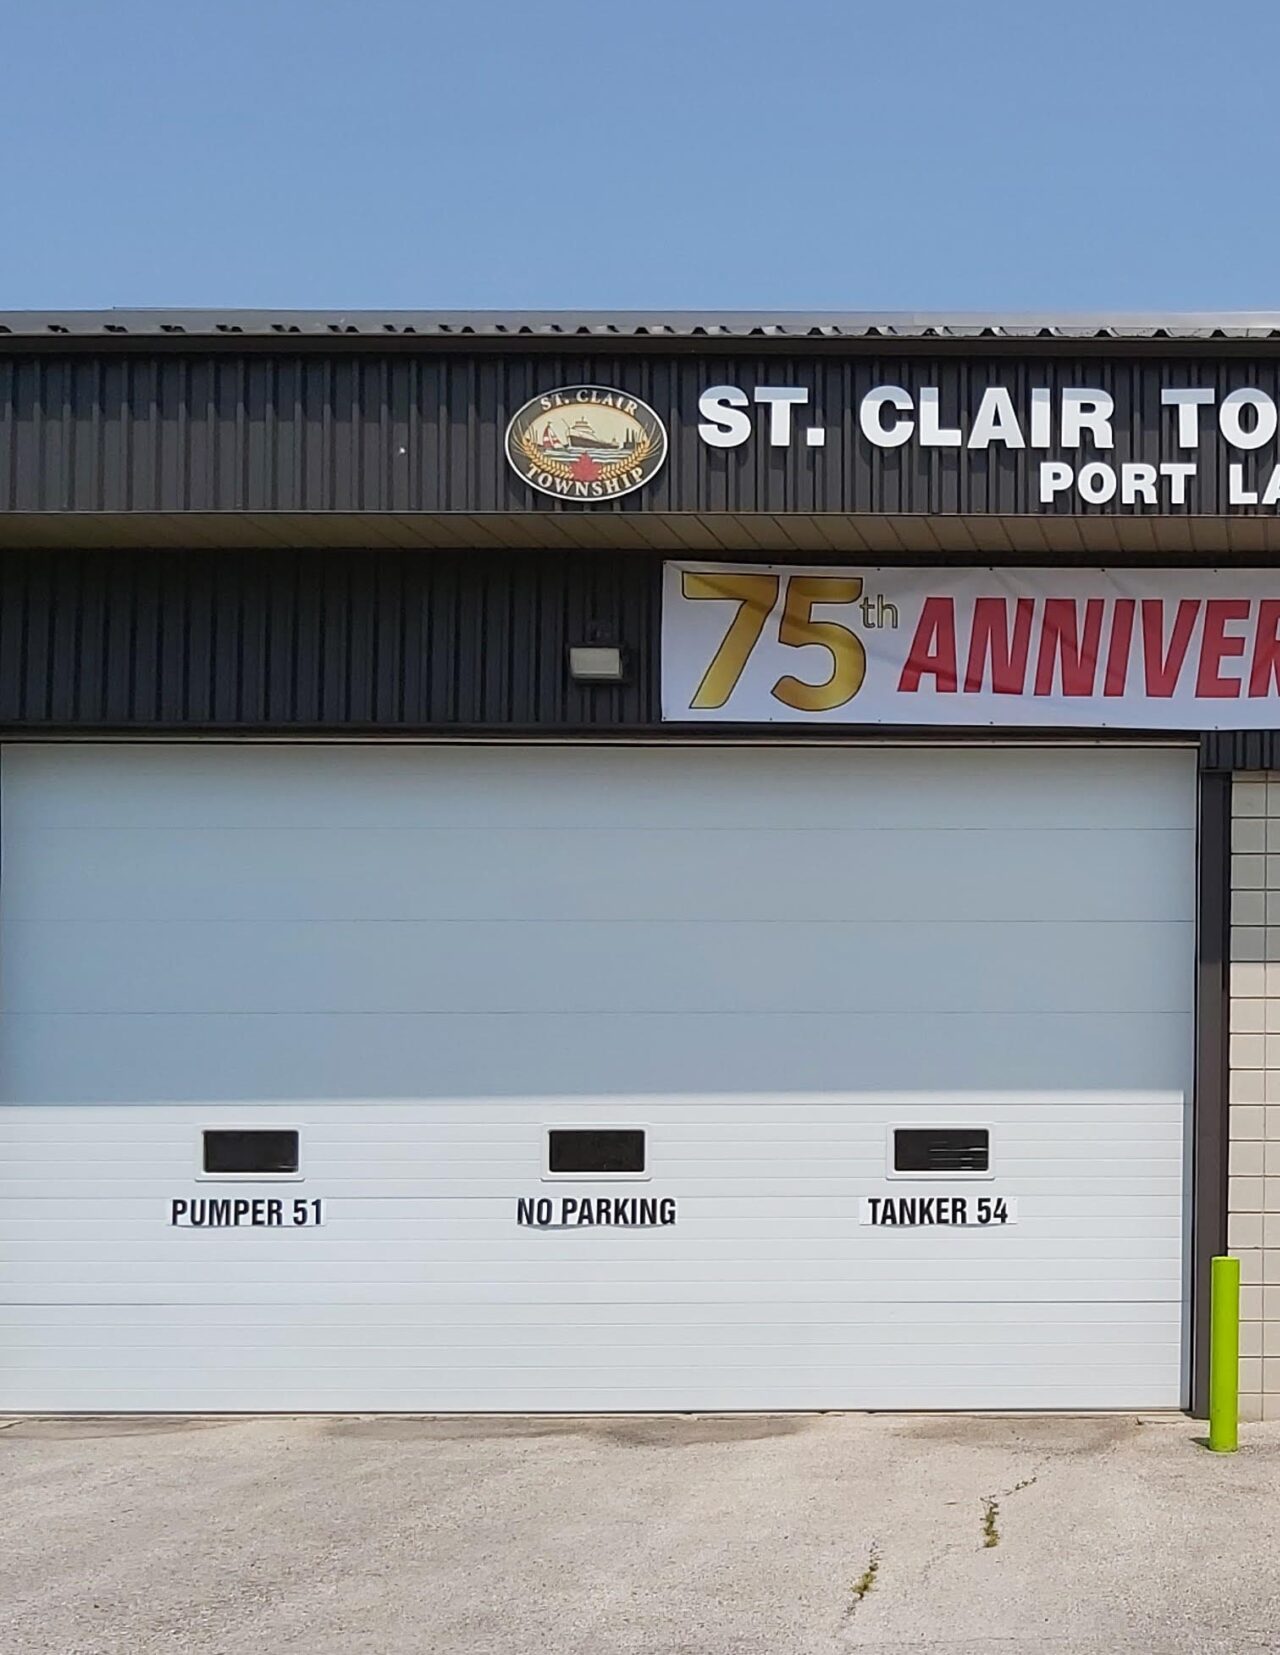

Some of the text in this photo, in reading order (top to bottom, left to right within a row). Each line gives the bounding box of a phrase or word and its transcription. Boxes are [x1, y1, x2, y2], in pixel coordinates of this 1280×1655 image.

[541, 389, 638, 416] ST. CLAIR
[698, 384, 825, 447] ST.
[859, 384, 1115, 449] CLAIR
[526, 463, 644, 497] TOWNSHIP
[1040, 461, 1197, 504] PORT
[171, 1198, 323, 1226] PUMPER 51
[516, 1197, 676, 1226] NO PARKING
[867, 1197, 1009, 1225] TANKER 54
